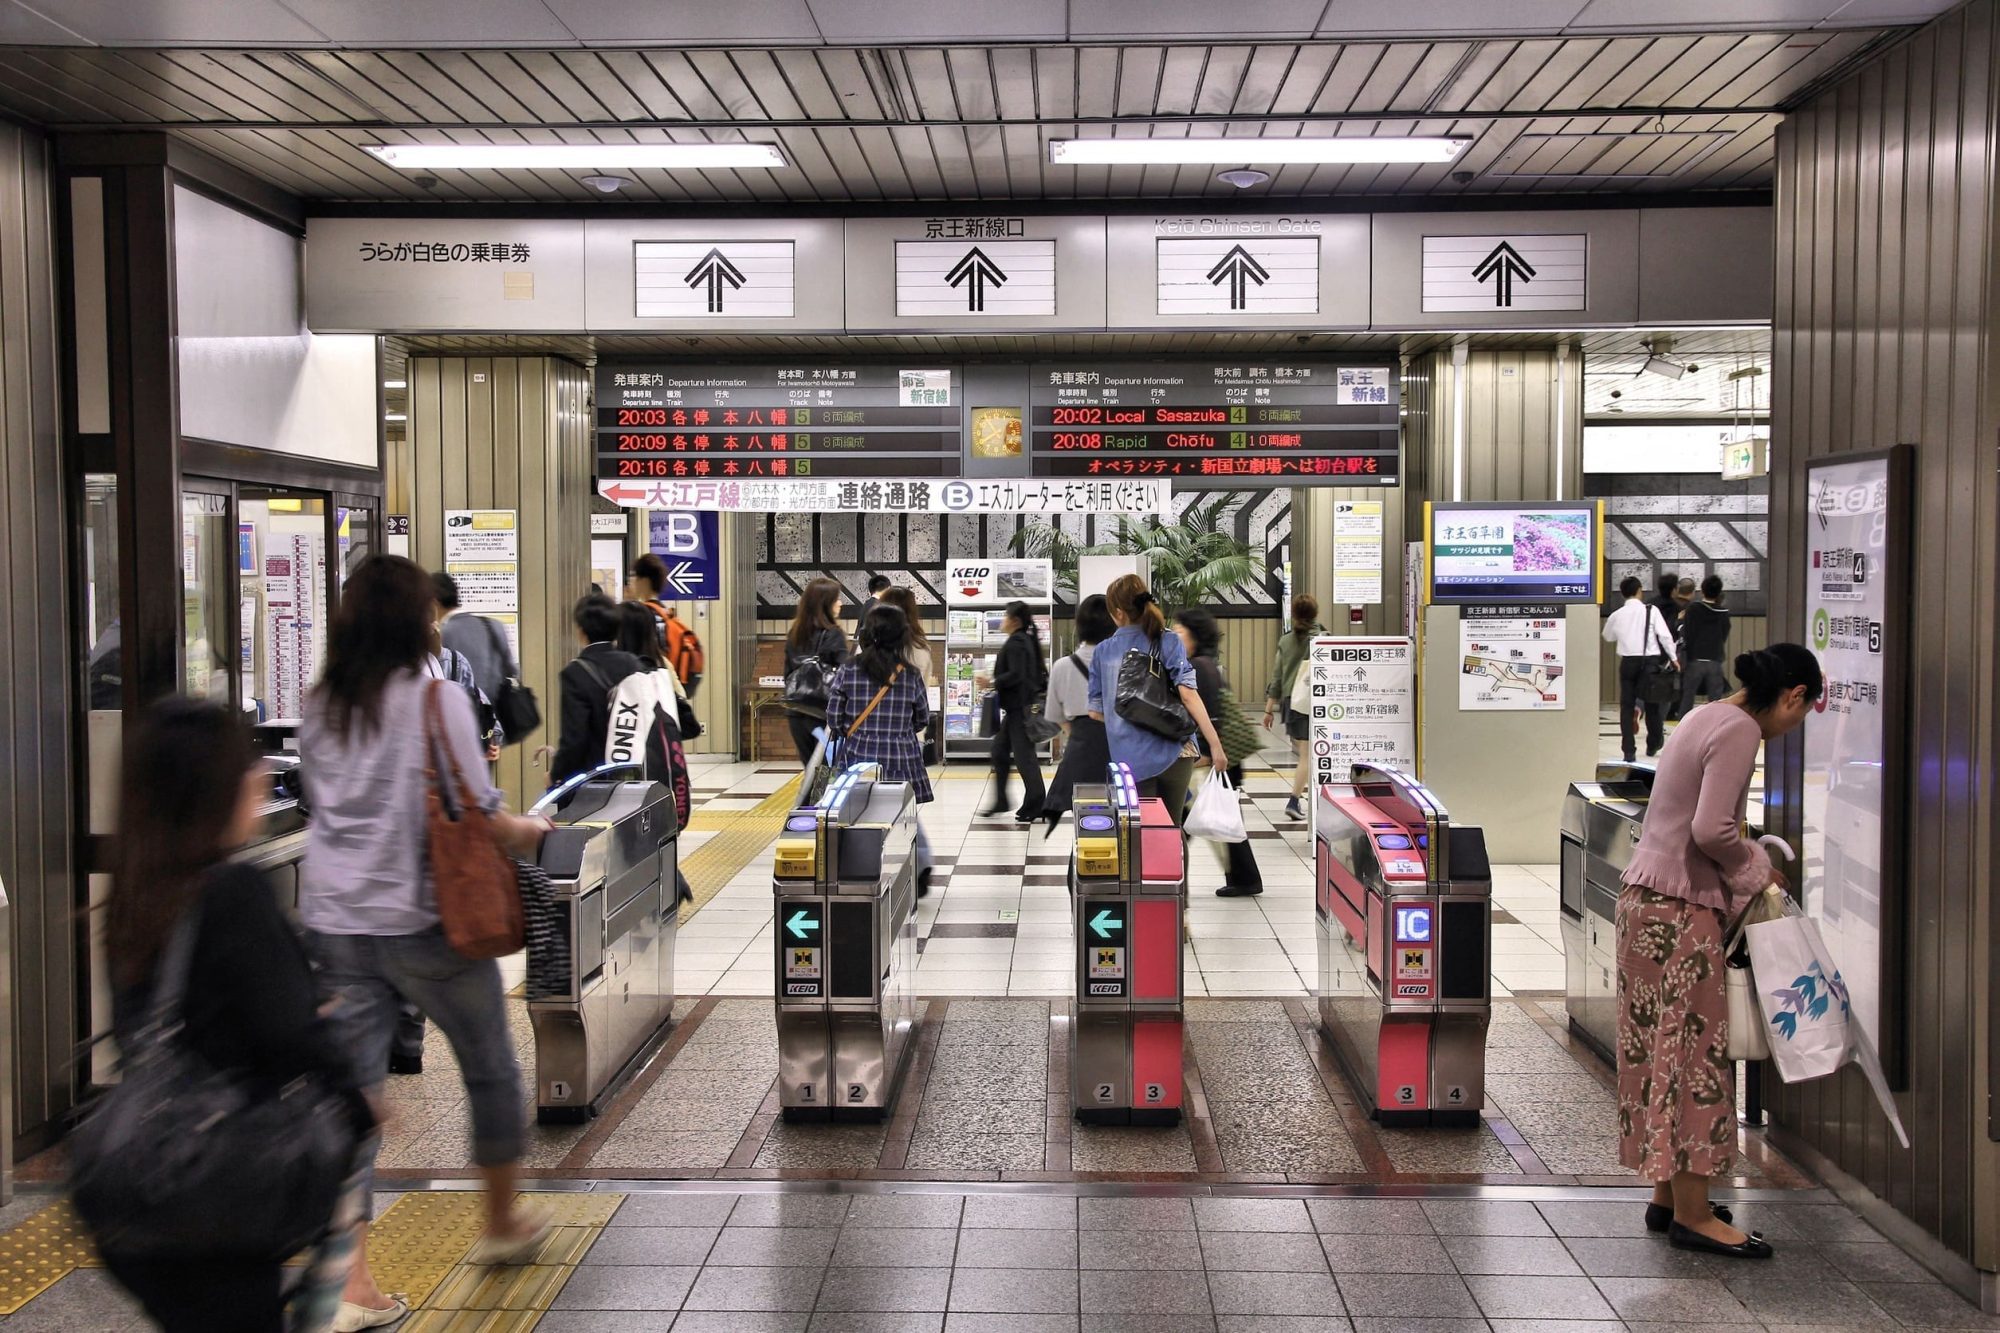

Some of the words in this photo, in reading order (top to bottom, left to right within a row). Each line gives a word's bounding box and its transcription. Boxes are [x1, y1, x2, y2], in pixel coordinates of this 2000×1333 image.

[925, 218, 1025, 239] 京王新線口
[1154, 218, 1195, 234] Keiō
[1199, 218, 1272, 234] Shinsen
[1277, 218, 1321, 234] Gate
[359, 241, 531, 263] うらが白色の乗車券
[777, 370, 804, 379] 岩本町
[812, 370, 839, 379] 本八幡
[841, 371, 857, 379] 方面
[1050, 372, 1099, 385] 発車案内
[1214, 368, 1242, 378] 明大前
[1295, 369, 1311, 377] 方面
[1339, 371, 1374, 386] 京王
[614, 373, 664, 387] 発車案内
[668, 379, 705, 387] Departure
[1104, 378, 1141, 386] Departure
[1143, 377, 1184, 385] Information
[714, 390, 730, 399] 行先
[789, 390, 811, 398] のりば
[910, 389, 948, 404] 新宿線
[1150, 389, 1166, 397] 行先
[1226, 388, 1248, 396] のりば
[1352, 387, 1386, 403] 新線
[618, 409, 666, 425] 20:03
[797, 409, 808, 424] 5
[1053, 408, 1101, 424] 20:02
[1106, 409, 1145, 423] Local
[1156, 409, 1226, 423] Sasazuka
[1233, 408, 1244, 422] 4
[618, 435, 666, 450] 20:09
[797, 435, 808, 449] 5
[1053, 434, 1101, 449] 20:08
[1105, 435, 1147, 450] Rapid
[1166, 433, 1214, 447] Chōfu
[1233, 433, 1244, 447] 4
[618, 460, 667, 476] 20:16
[797, 459, 808, 474] 5
[1088, 457, 1377, 475] オペラシティ・新国立劇場へは初台駅を
[647, 482, 741, 508] 大江戸線
[837, 482, 931, 510] 連絡通路
[945, 484, 970, 509] B
[979, 480, 1158, 511] エスカレーターをご利用ください
[669, 513, 699, 552] B
[952, 567, 990, 578] KEIO
[1854, 557, 1863, 580] 4
[1554, 585, 1586, 594] 京王では
[1818, 622, 1823, 637] S
[1870, 626, 1879, 650] 5
[1346, 650, 1356, 660] 2
[1360, 650, 1370, 660] 3
[1373, 648, 1407, 659] 京王線
[1314, 685, 1324, 696] 4
[1326, 683, 1369, 693] 京王新線
[1315, 707, 1324, 717] 5
[611, 702, 639, 763] ONEX
[1320, 758, 1330, 768] 6
[1321, 773, 1329, 784] 7
[1397, 910, 1430, 939] IC
[789, 984, 817, 993] KEIO
[1092, 984, 1120, 993] KEIO
[1399, 985, 1427, 994] KEIO
[554, 1084, 564, 1096] 1
[803, 1086, 812, 1098] 1
[850, 1086, 861, 1098] 2
[1100, 1086, 1111, 1098] 2
[1148, 1086, 1159, 1098] 3
[1401, 1087, 1412, 1099] 3
[1449, 1087, 1461, 1099] 4
